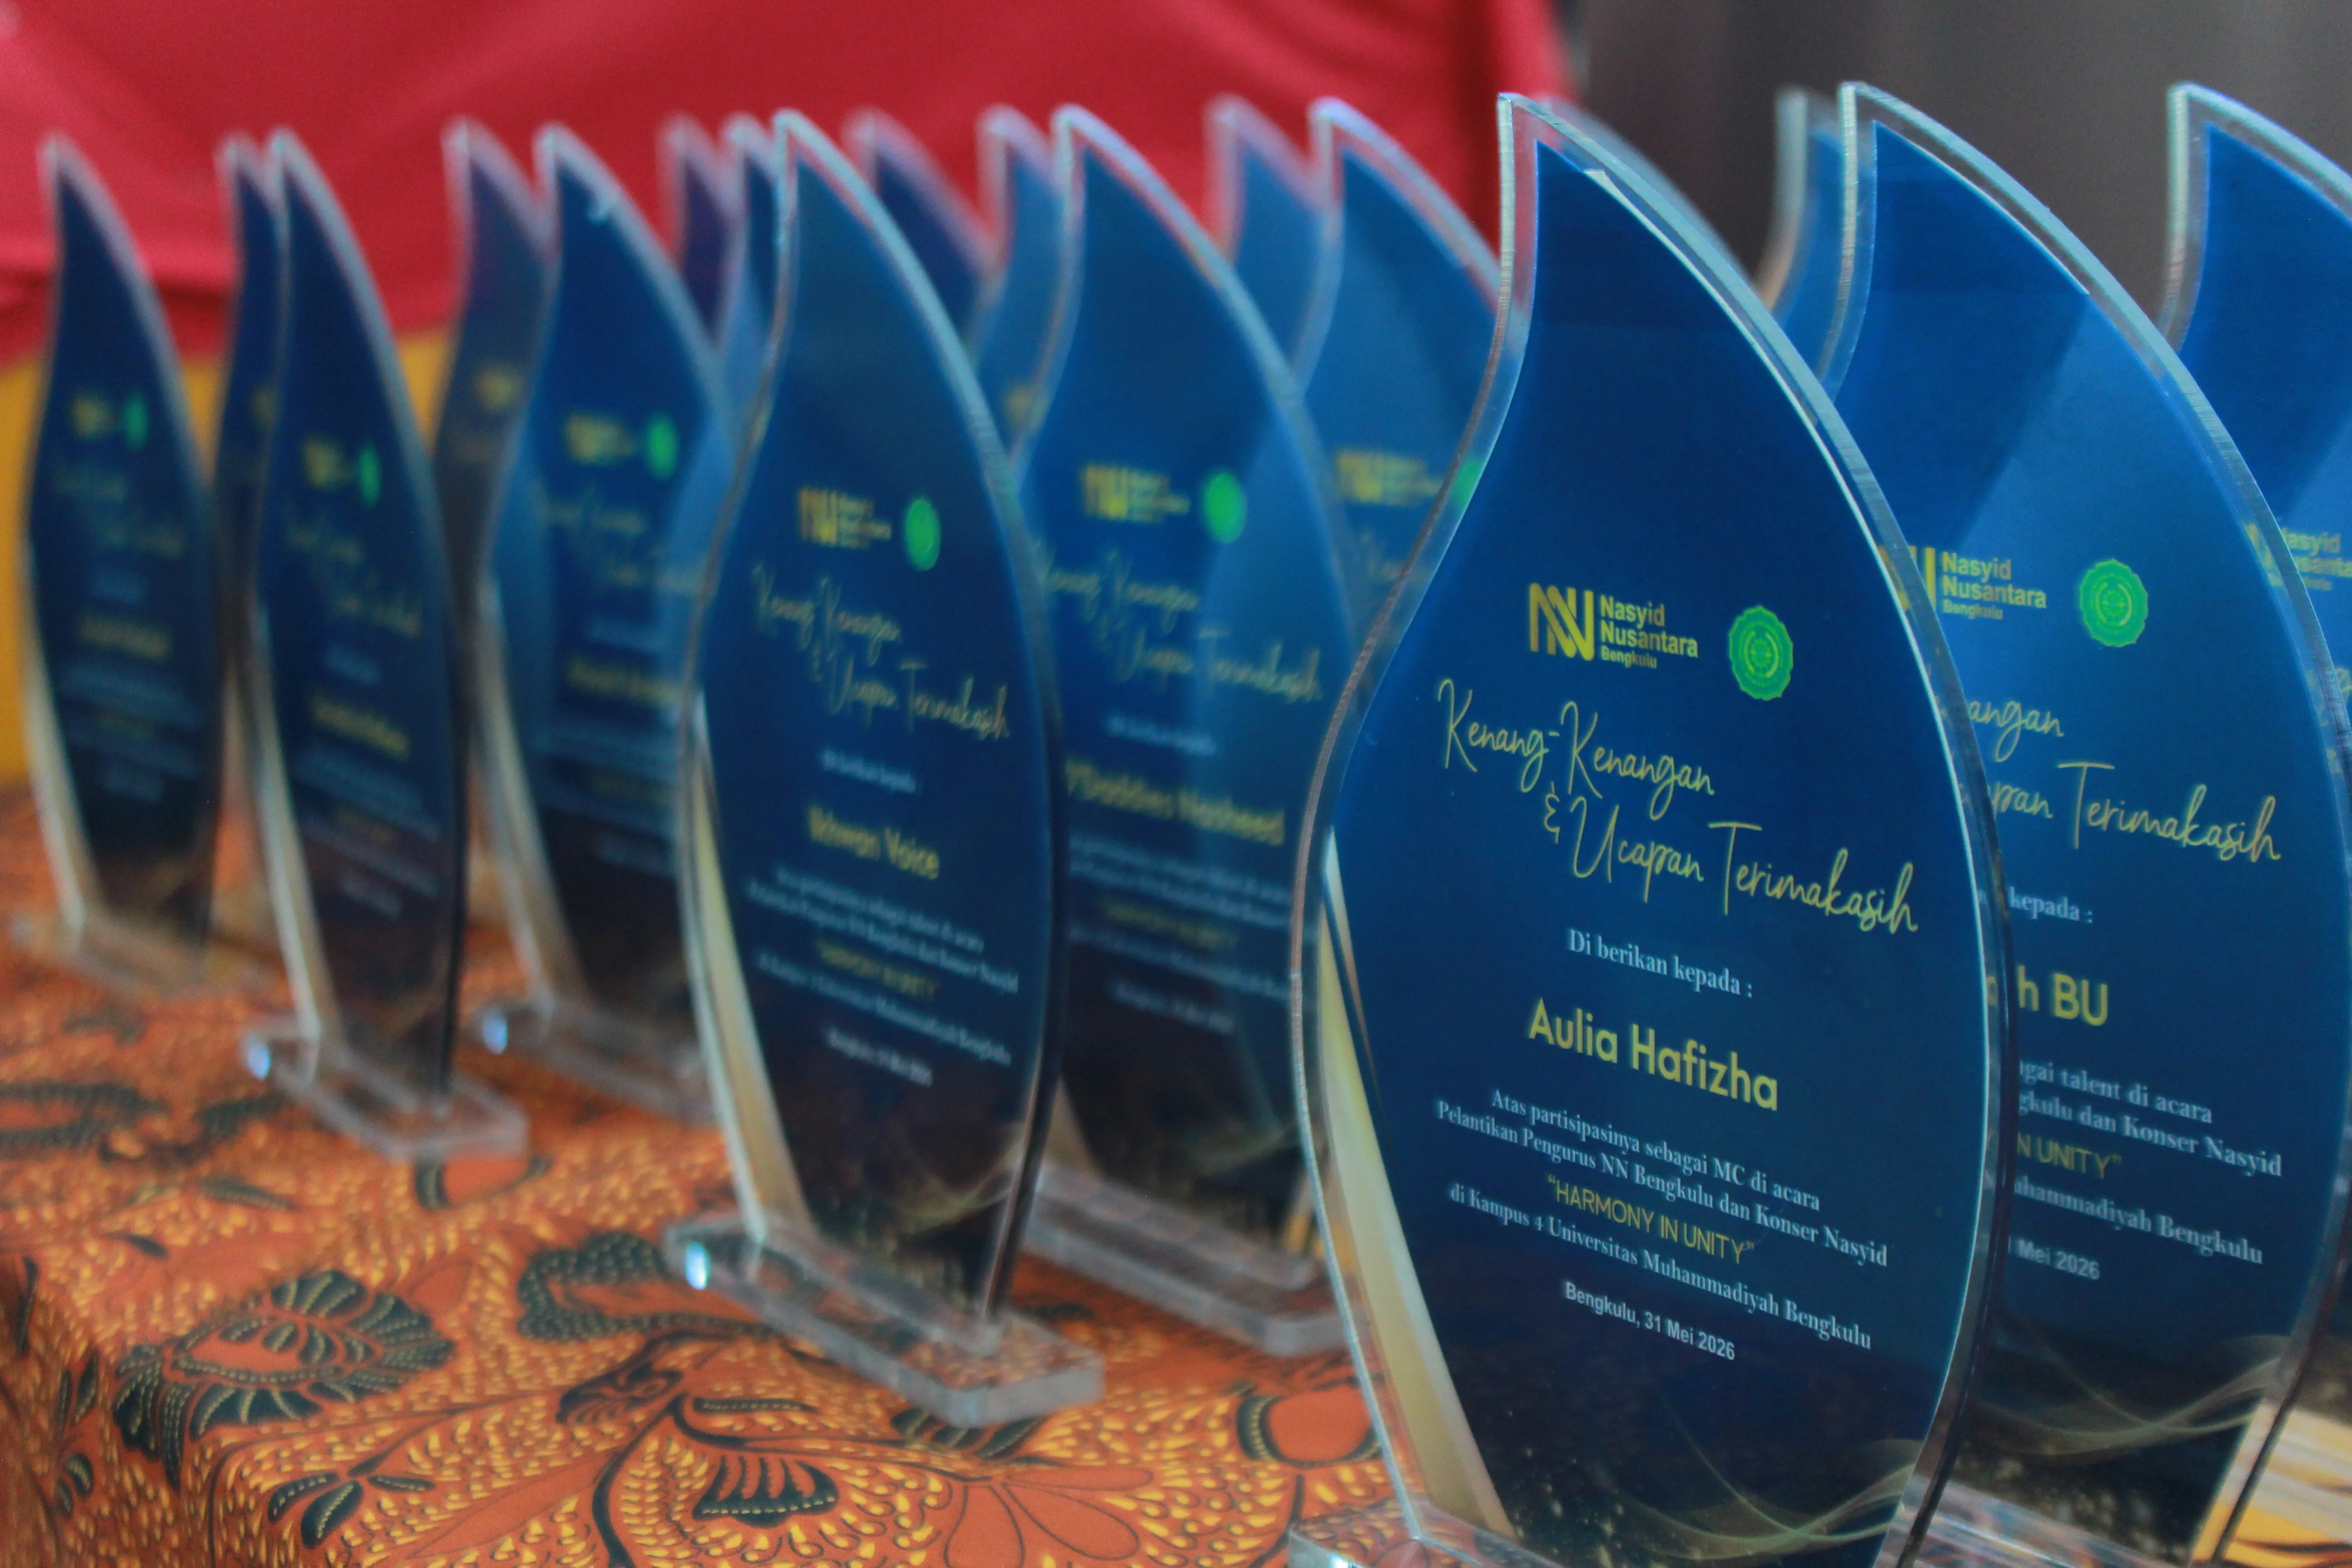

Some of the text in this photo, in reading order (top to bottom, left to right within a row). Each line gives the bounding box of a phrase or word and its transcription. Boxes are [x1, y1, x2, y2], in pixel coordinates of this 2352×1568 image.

[1942, 551, 2011, 583] Nasyid
[1942, 575, 2047, 608] Nusantara
[1601, 595, 1665, 629] Nasyid
[1601, 620, 1698, 657] Nusantara
[1601, 645, 1657, 668] Bengkulu
[1438, 679, 1715, 820] Kenang-Kenangan
[2058, 761, 2282, 862] Terimakasih
[1571, 796, 1704, 902] Ucapan
[1709, 822, 1918, 934] Terimakasih
[1569, 929, 1591, 955] Di
[1597, 935, 1667, 975] berikan
[1674, 955, 1740, 992] kepada
[2053, 973, 2108, 1026] BU
[1529, 998, 1777, 1111] Aulia Hafizha
[2060, 1069, 2121, 1100] talent
[2127, 1083, 2148, 1107] di
[2155, 1096, 2212, 1124] acara
[1492, 1088, 1820, 1211] Atas partisipasinya sebagai MC di acara
[2078, 1105, 2116, 1132] dan
[2123, 1114, 2199, 1153] Konser
[2203, 1136, 2282, 1177] Nasyid
[1437, 1100, 1887, 1267] Pelantikan Pengurus NN Bengkulu dan Konser Nasyid
[1661, 1215, 1678, 1243] IN
[2157, 1215, 2263, 1264] Bengkulu
[1451, 1183, 1871, 1349] di Kampus 4 Universitas Muhammadiyah Bengkulu
[2017, 1238, 2050, 1264] Mei
[2056, 1251, 2100, 1280] 2026
[1566, 1282, 1735, 1360] Bengkulu, 31 Mei 2026
